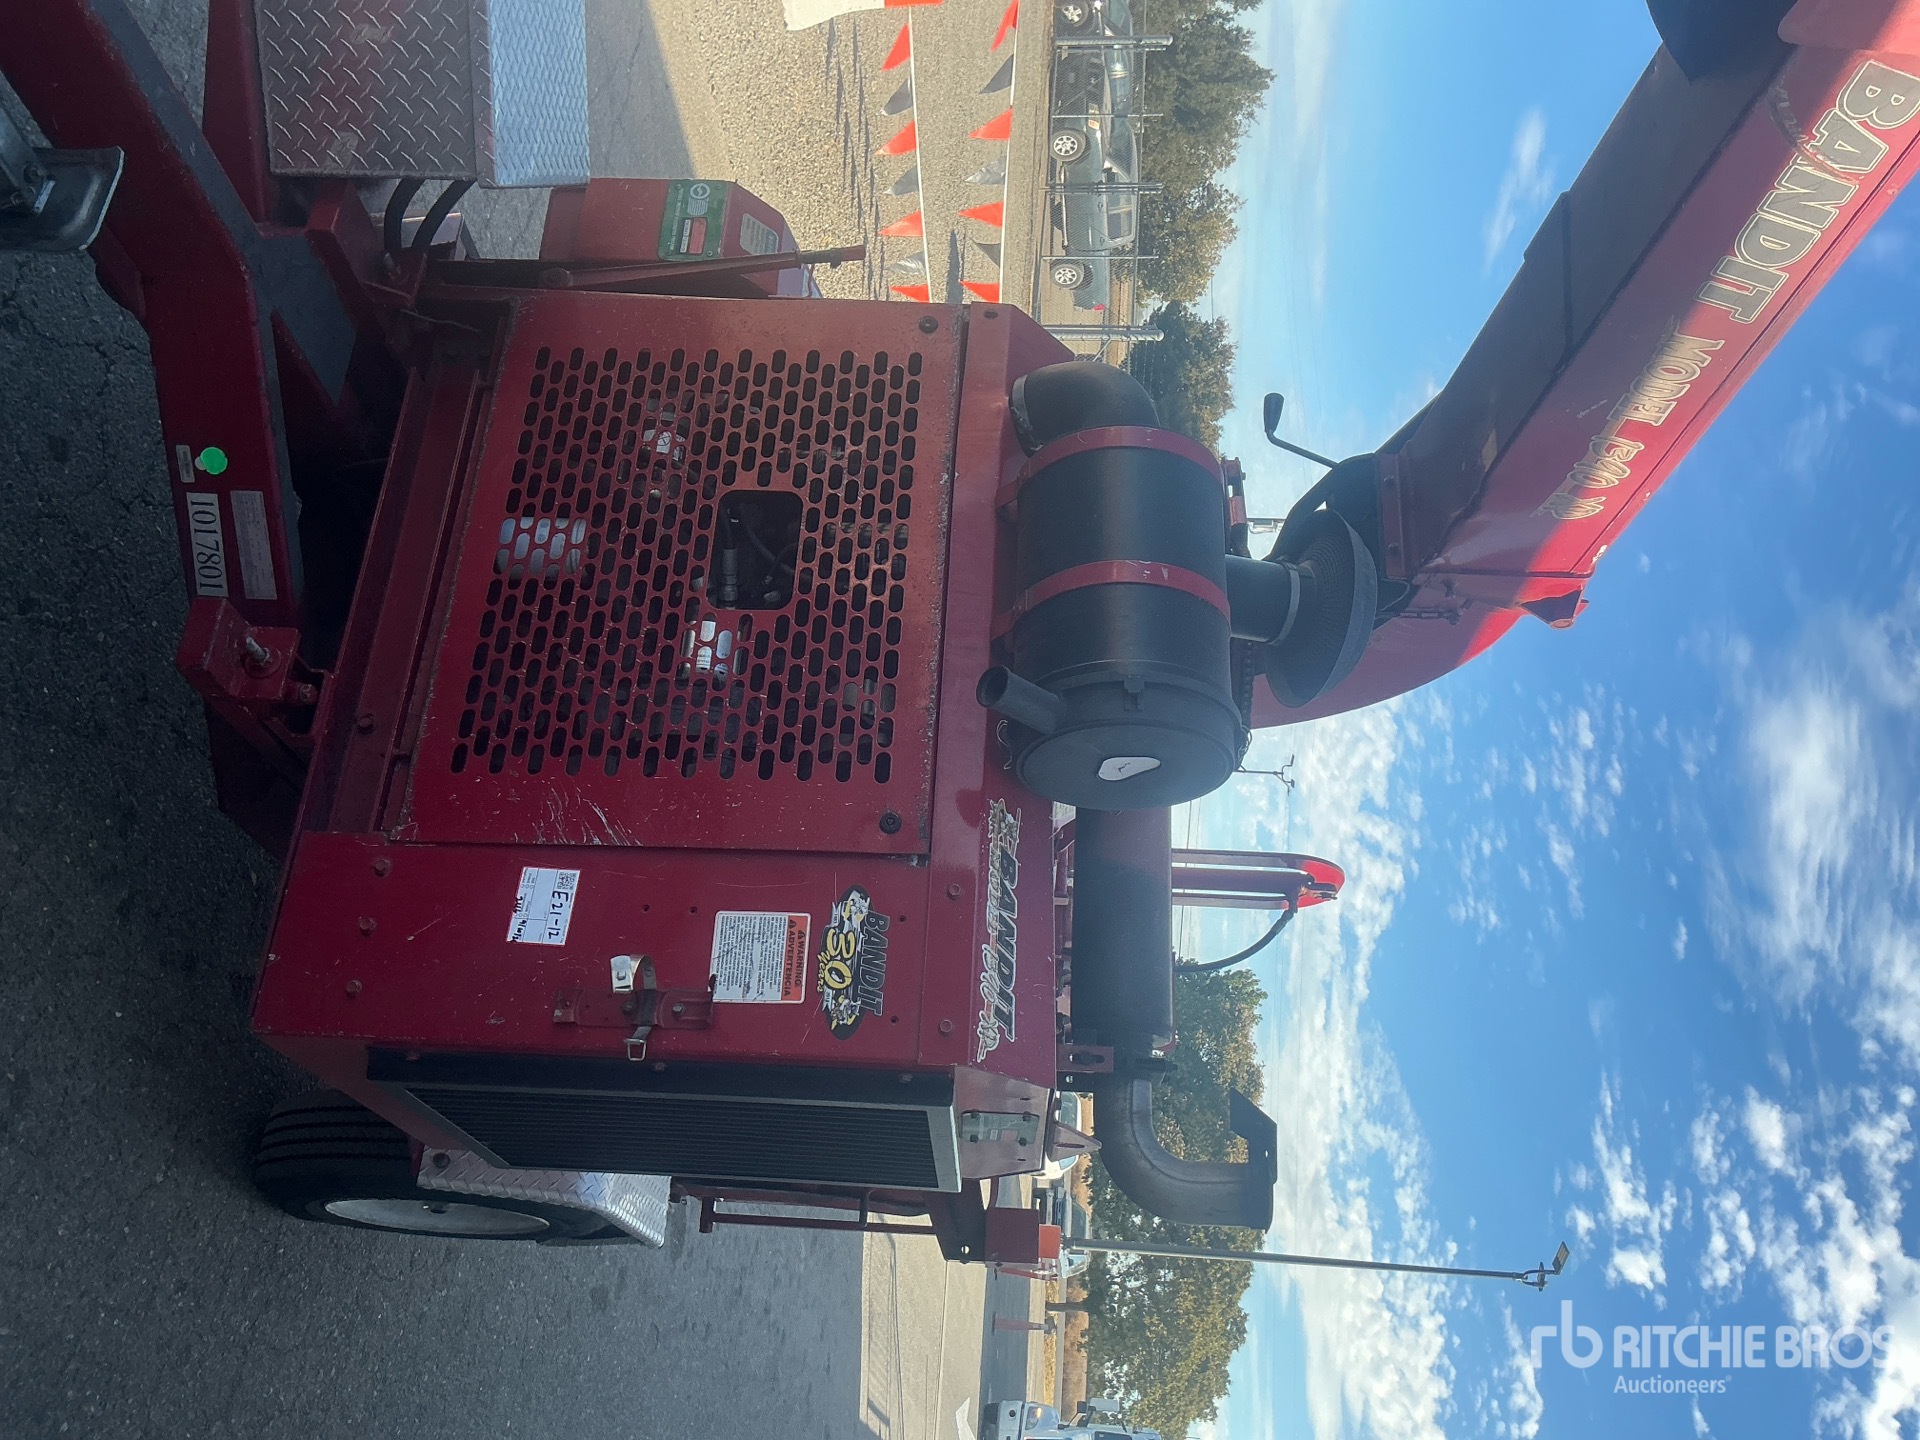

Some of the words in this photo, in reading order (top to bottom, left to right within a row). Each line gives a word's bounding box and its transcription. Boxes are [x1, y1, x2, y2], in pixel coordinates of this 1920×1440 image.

[1694, 59, 1920, 324] BANDIT
[1607, 334, 1725, 425] MODEL
[191, 500, 223, 590] 1017801
[784, 930, 795, 996] ADVERTENCIA
[794, 940, 804, 987] WARNING
[816, 949, 831, 993] Years
[824, 928, 856, 990] 30
[858, 911, 891, 1016] BANDIT
[993, 845, 1018, 1042] BANDIT
